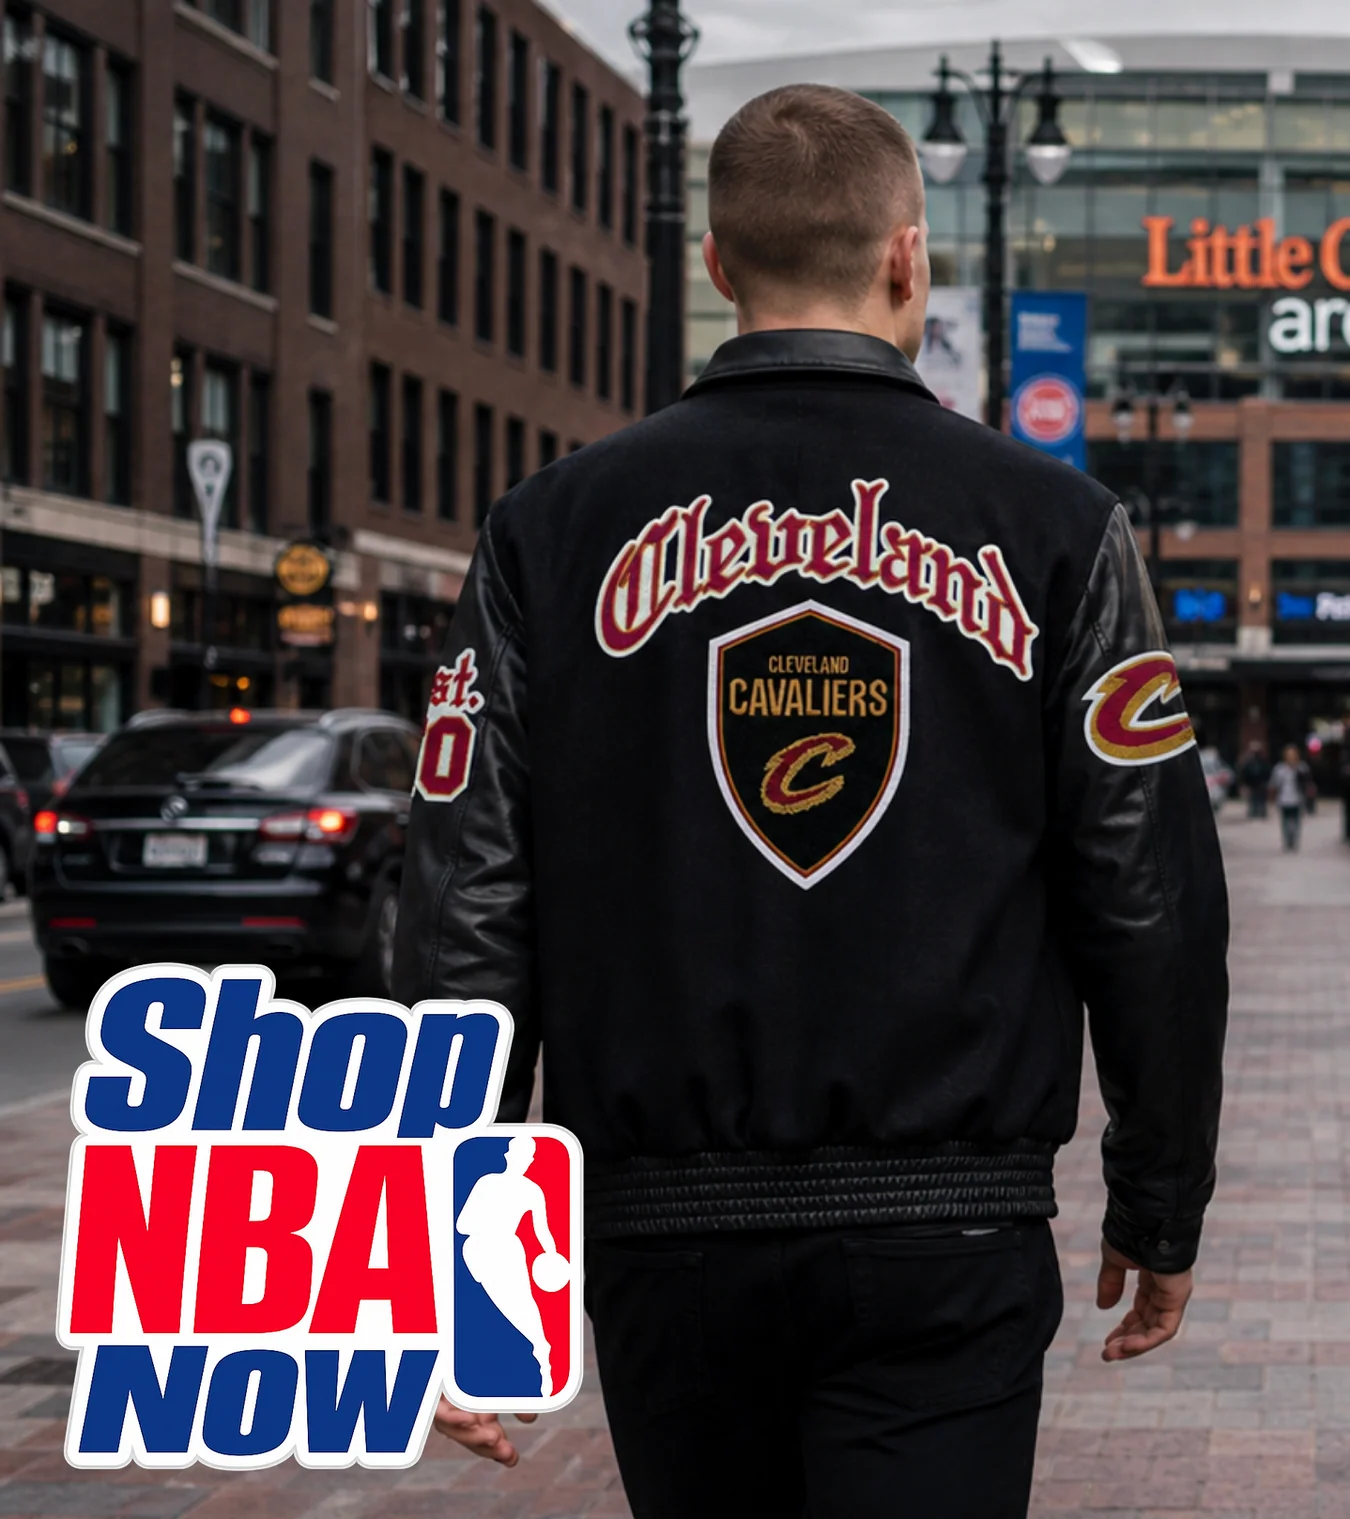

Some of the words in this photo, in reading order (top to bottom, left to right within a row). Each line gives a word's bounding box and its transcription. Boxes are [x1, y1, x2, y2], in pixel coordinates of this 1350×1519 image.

[1142, 216, 1313, 289] Little
[598, 479, 1037, 679] Cleveland
[428, 649, 484, 714] st.
[728, 677, 888, 717] CAVALIERS
[768, 654, 849, 674] CLEVELAND
[416, 715, 476, 801] 0
